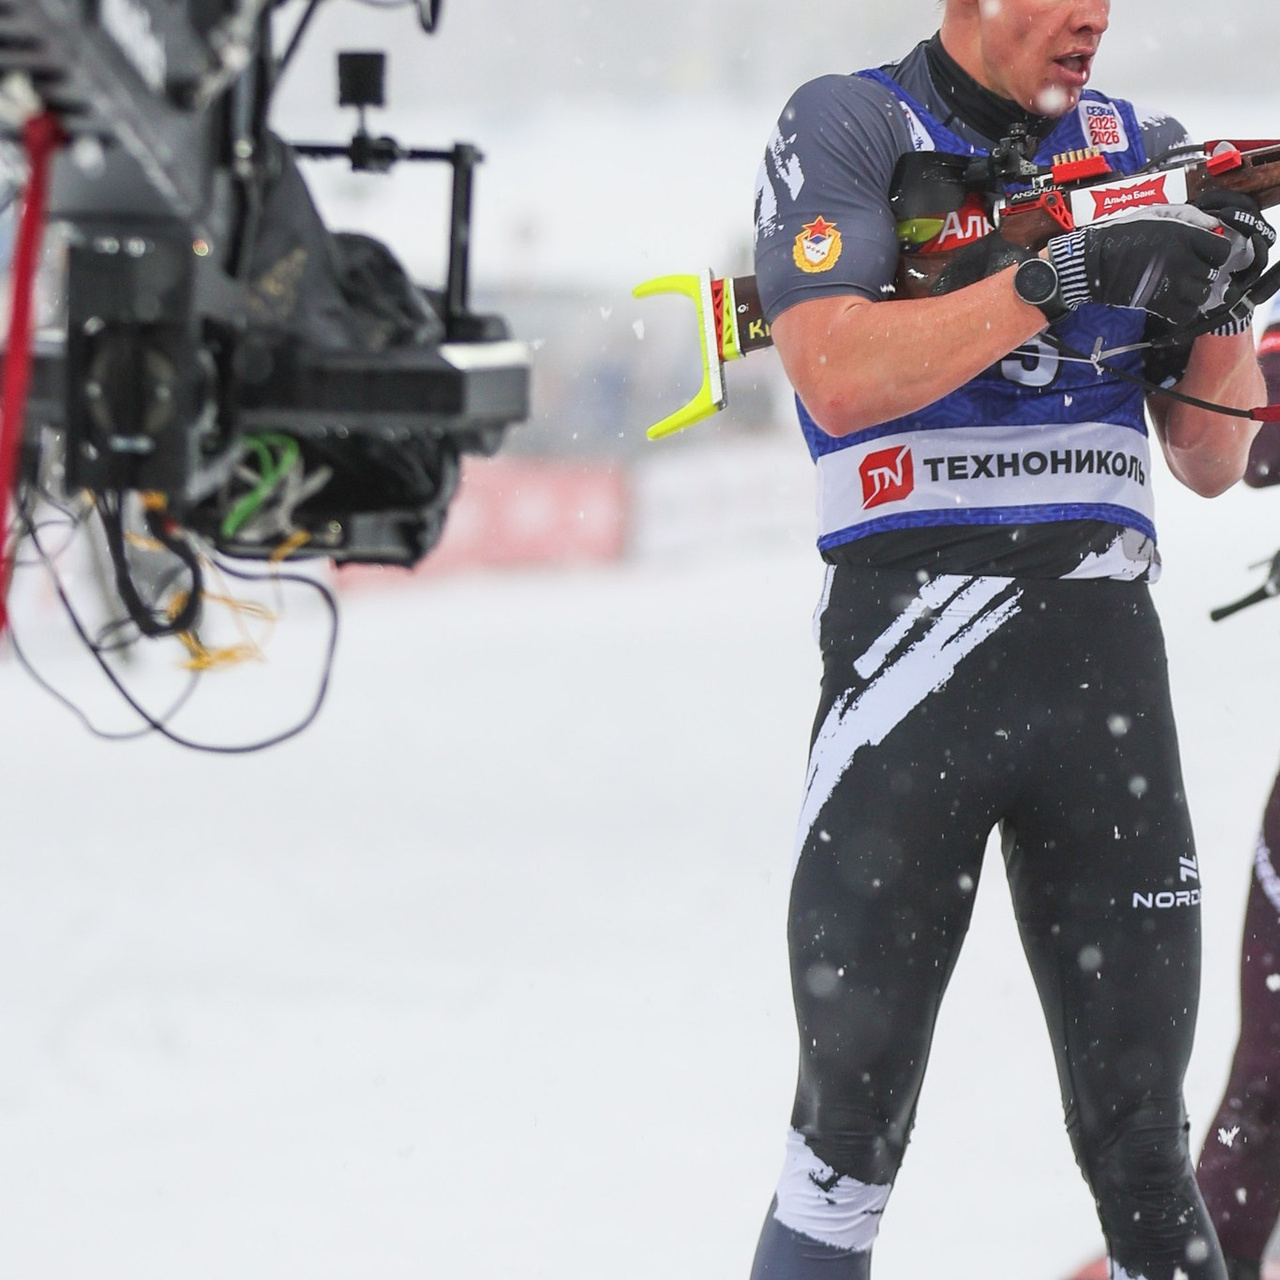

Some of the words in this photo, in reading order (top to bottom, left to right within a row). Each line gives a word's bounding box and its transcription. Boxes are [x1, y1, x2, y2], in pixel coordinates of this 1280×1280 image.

[1088, 116, 1117, 130] 2025
[1091, 130, 1120, 145] 2026
[1104, 194, 1133, 208] Альфа
[1134, 188, 1156, 200] Банк
[923, 449, 1146, 487] ТЕХНОНИКОЛЬ
